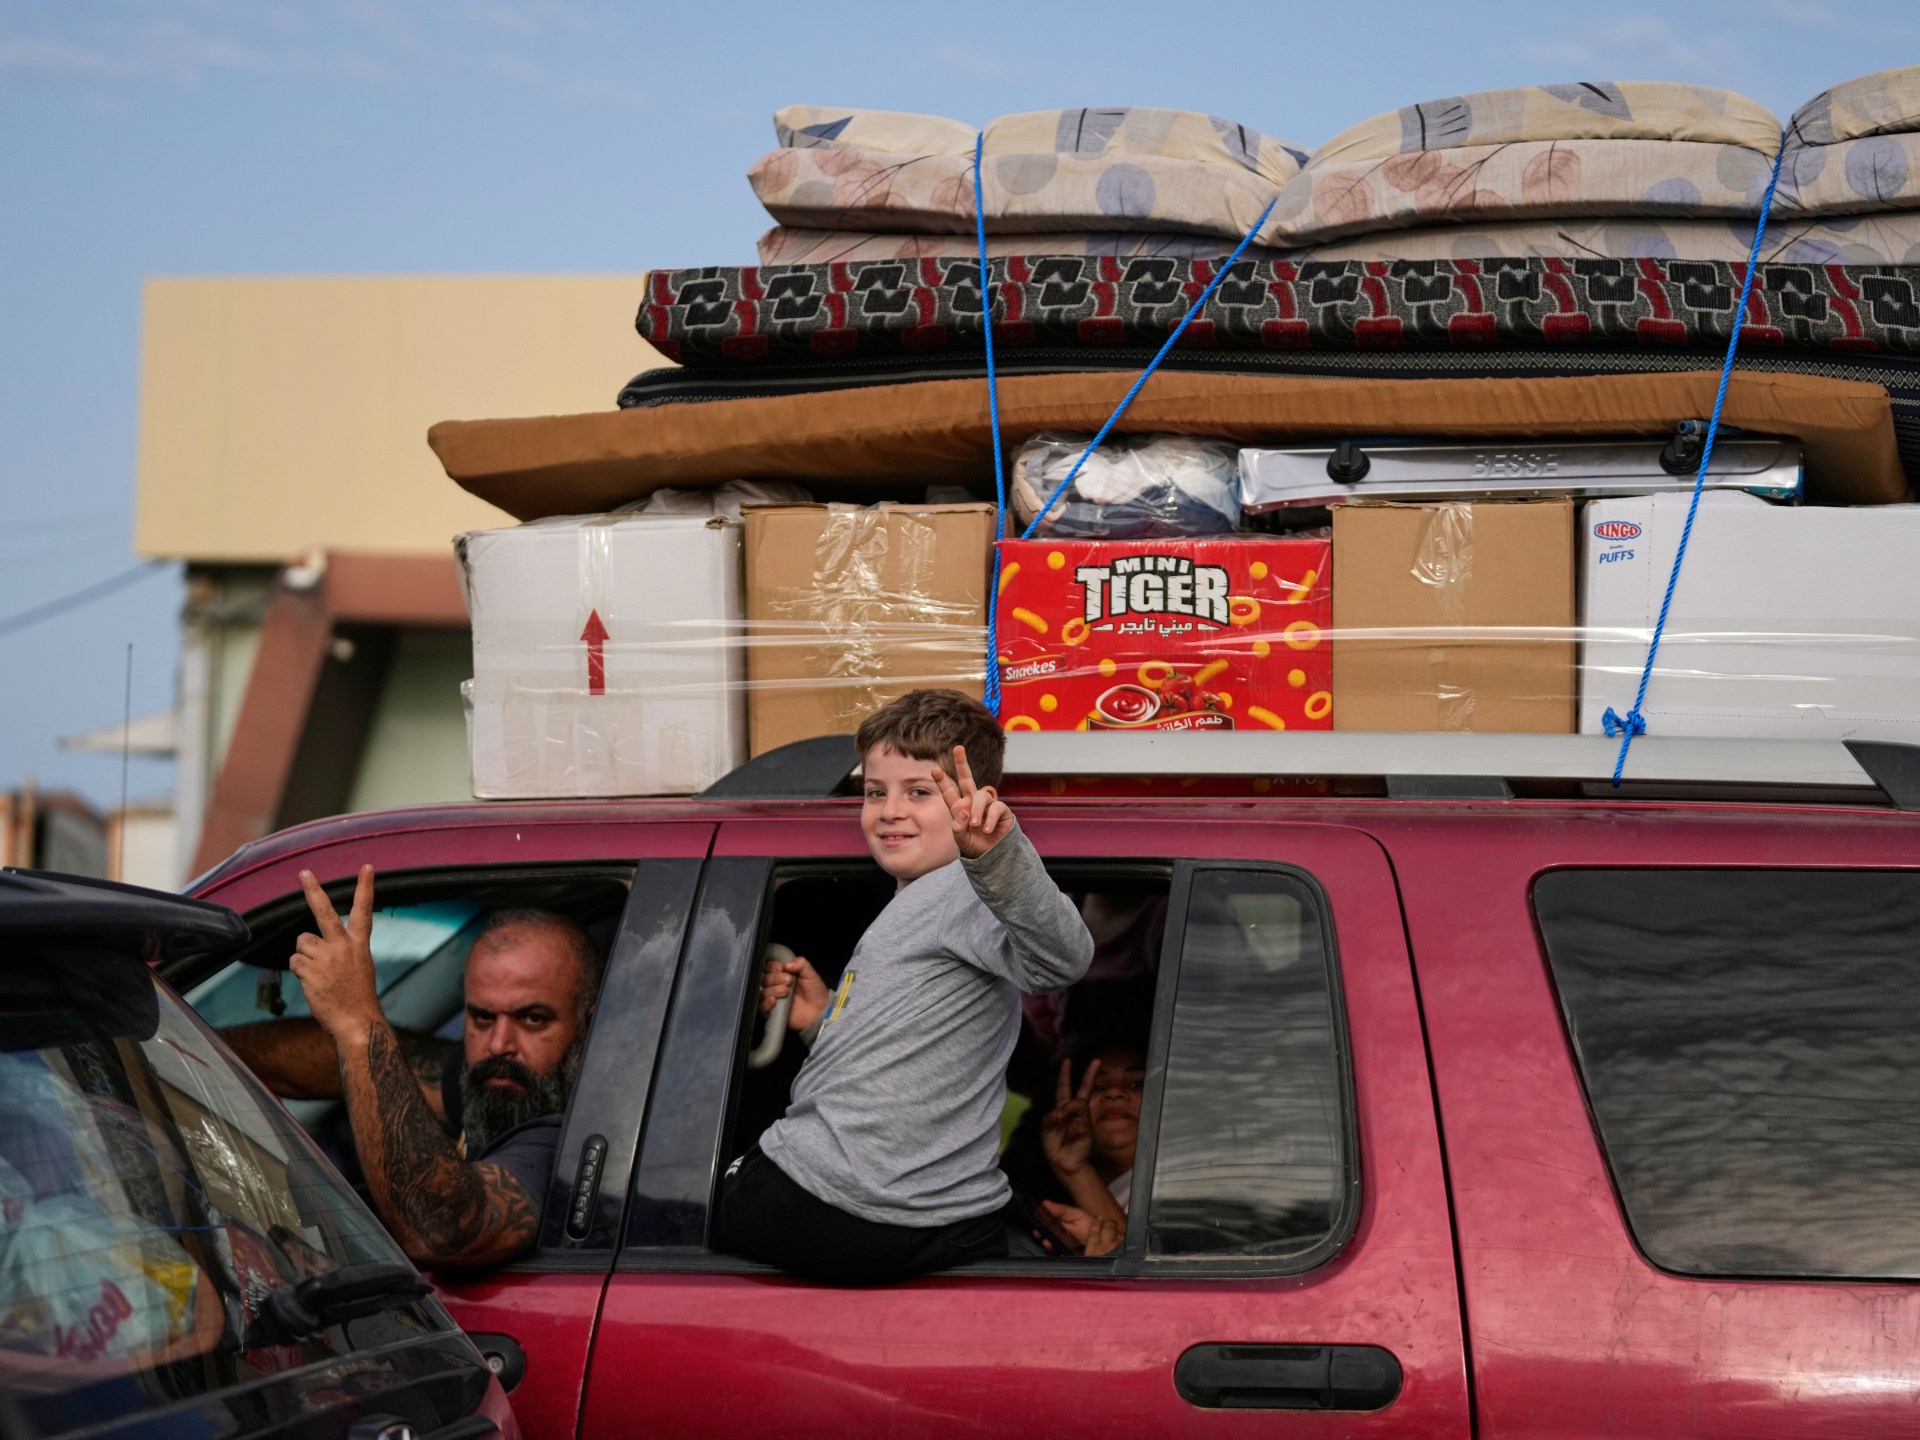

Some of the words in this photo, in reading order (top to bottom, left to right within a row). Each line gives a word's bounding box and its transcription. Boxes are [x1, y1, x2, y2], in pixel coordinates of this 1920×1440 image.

[1471, 453, 1559, 477] BESSE
[1597, 523, 1639, 538] RINGO
[1114, 556, 1190, 574] MINI
[1598, 549, 1635, 564] PUFFS
[1076, 567, 1229, 625] TIGER
[1117, 617, 1156, 635] تايجر
[1158, 619, 1193, 637] ميني
[1195, 715, 1223, 728] طعم
